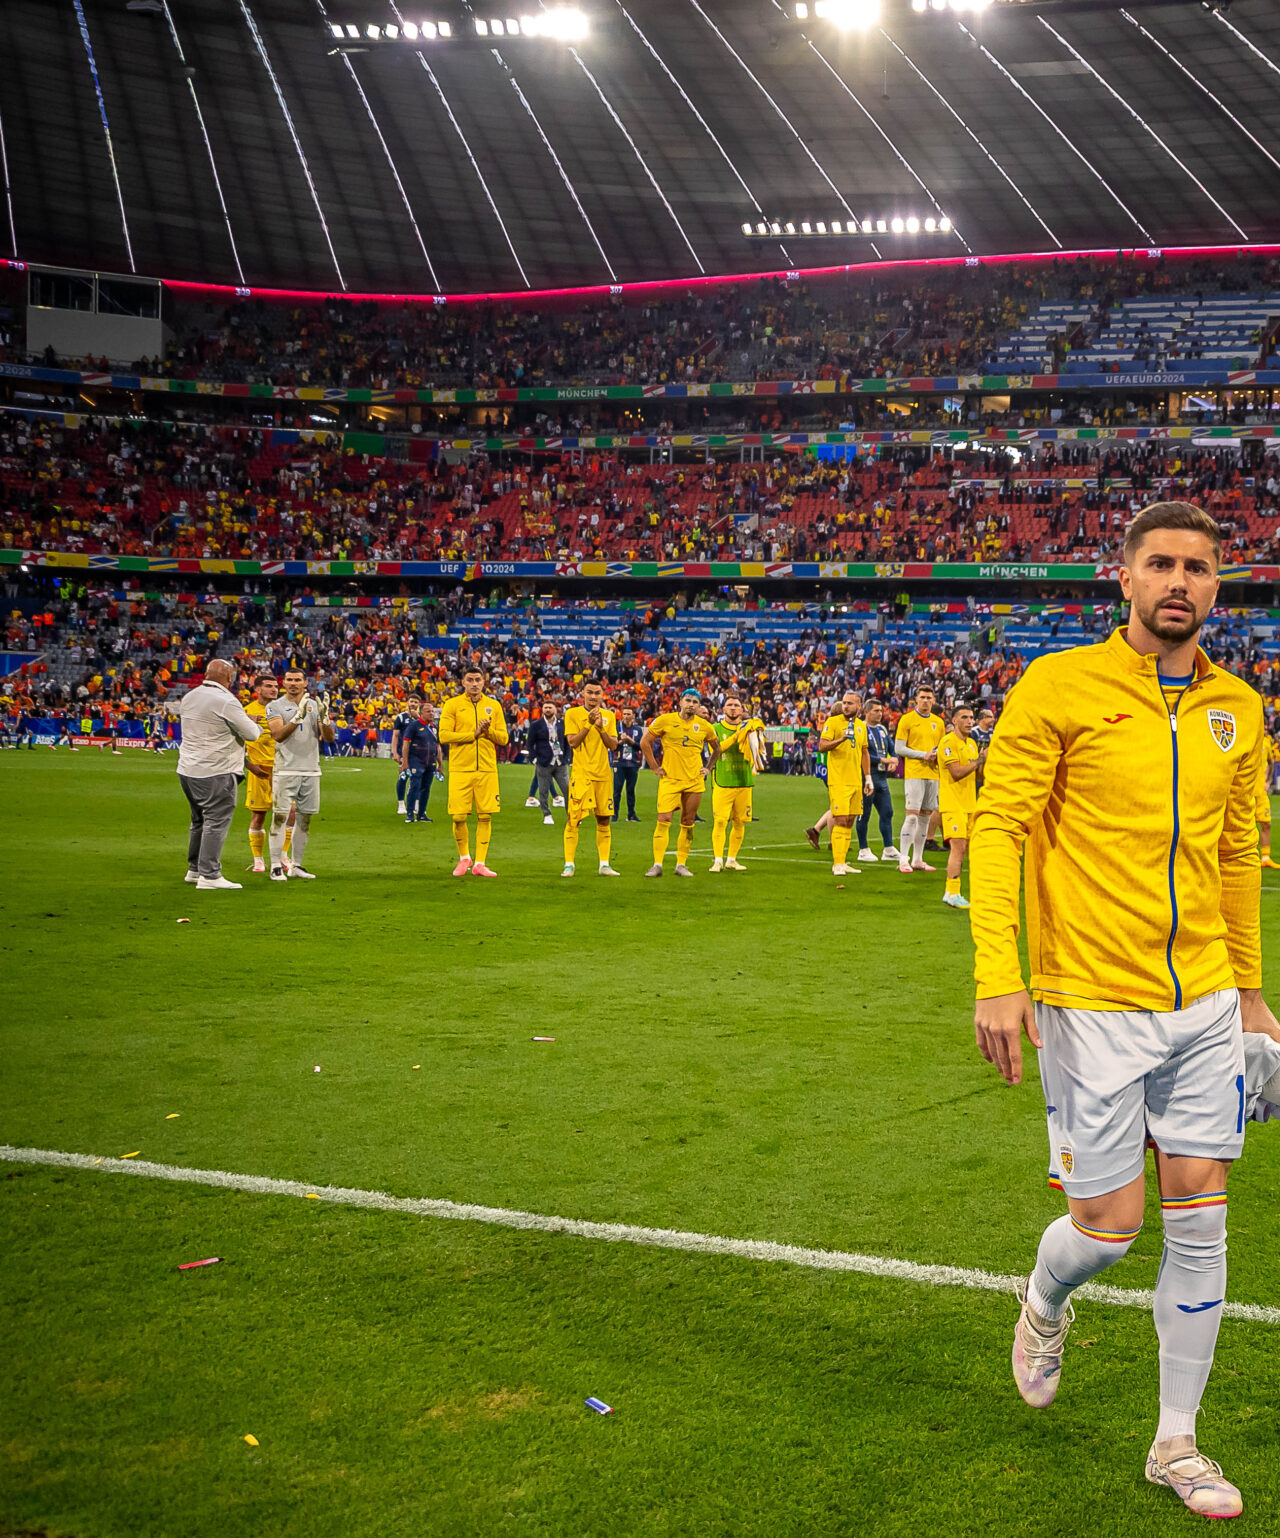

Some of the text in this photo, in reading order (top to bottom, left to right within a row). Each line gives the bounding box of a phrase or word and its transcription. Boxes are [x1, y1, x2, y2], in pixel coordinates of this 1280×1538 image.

[785, 271, 799, 280] 306
[609, 285, 622, 294] 307
[682, 735, 689, 747] 2
[1235, 1073, 1244, 1134] 1
